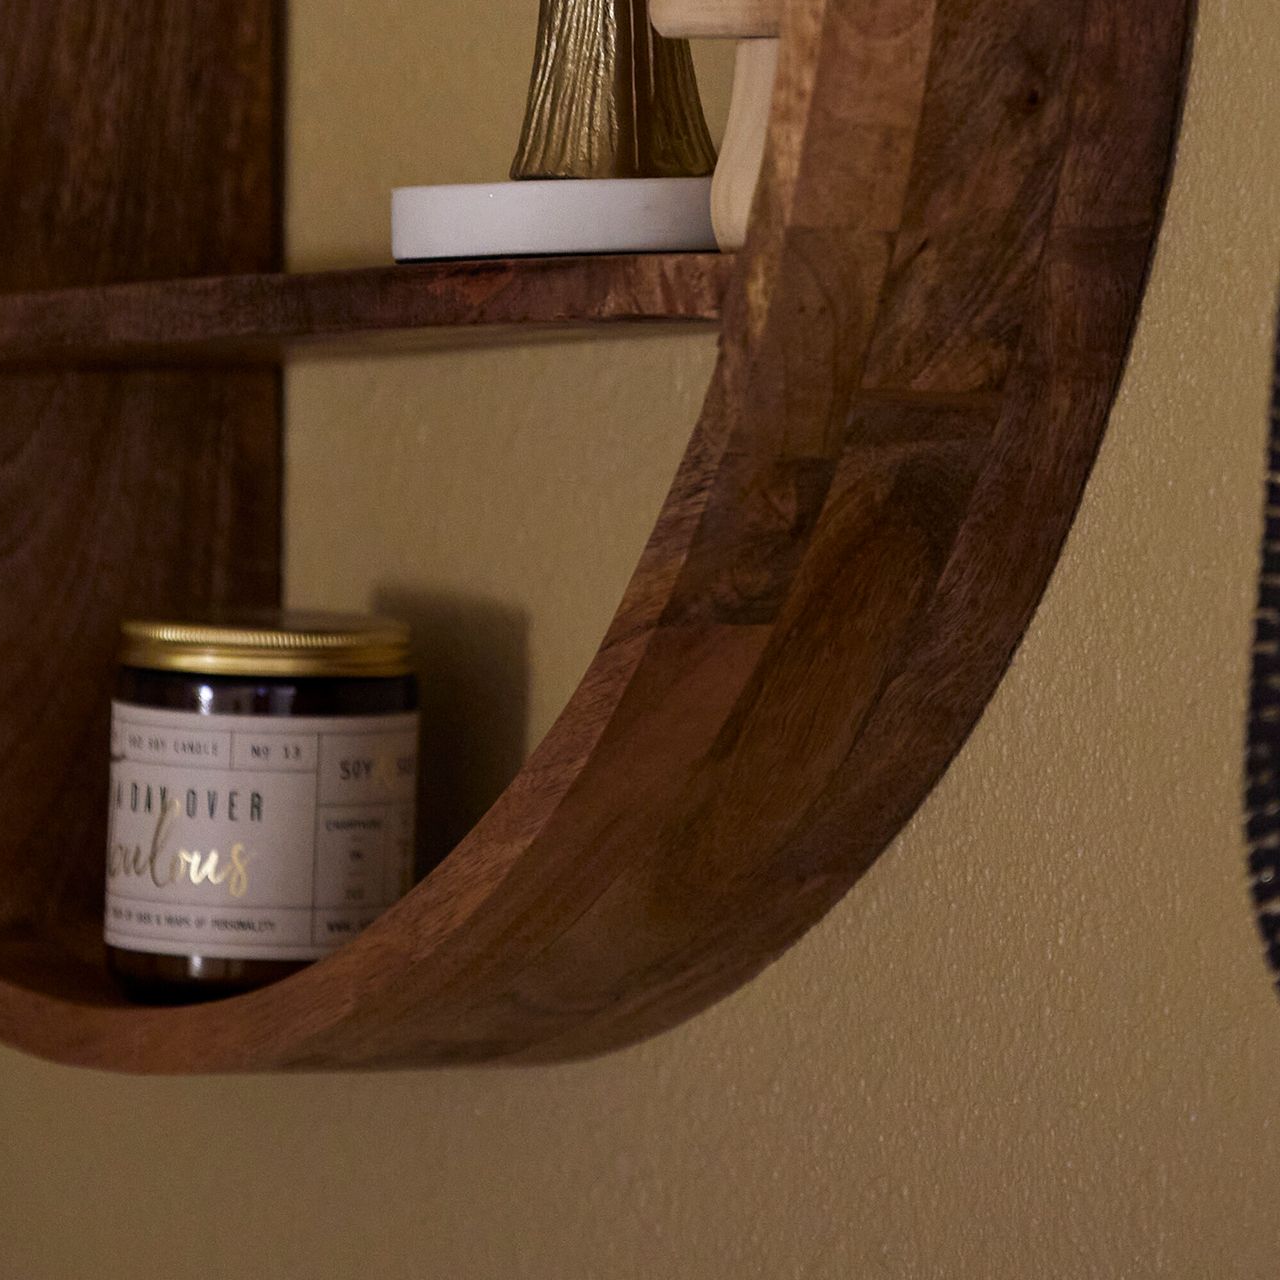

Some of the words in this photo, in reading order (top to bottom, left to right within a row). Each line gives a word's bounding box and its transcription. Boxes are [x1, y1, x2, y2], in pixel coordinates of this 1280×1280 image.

[173, 740, 219, 757] CANDLE
[339, 759, 372, 780] SOY
[185, 788, 264, 823] OVER
